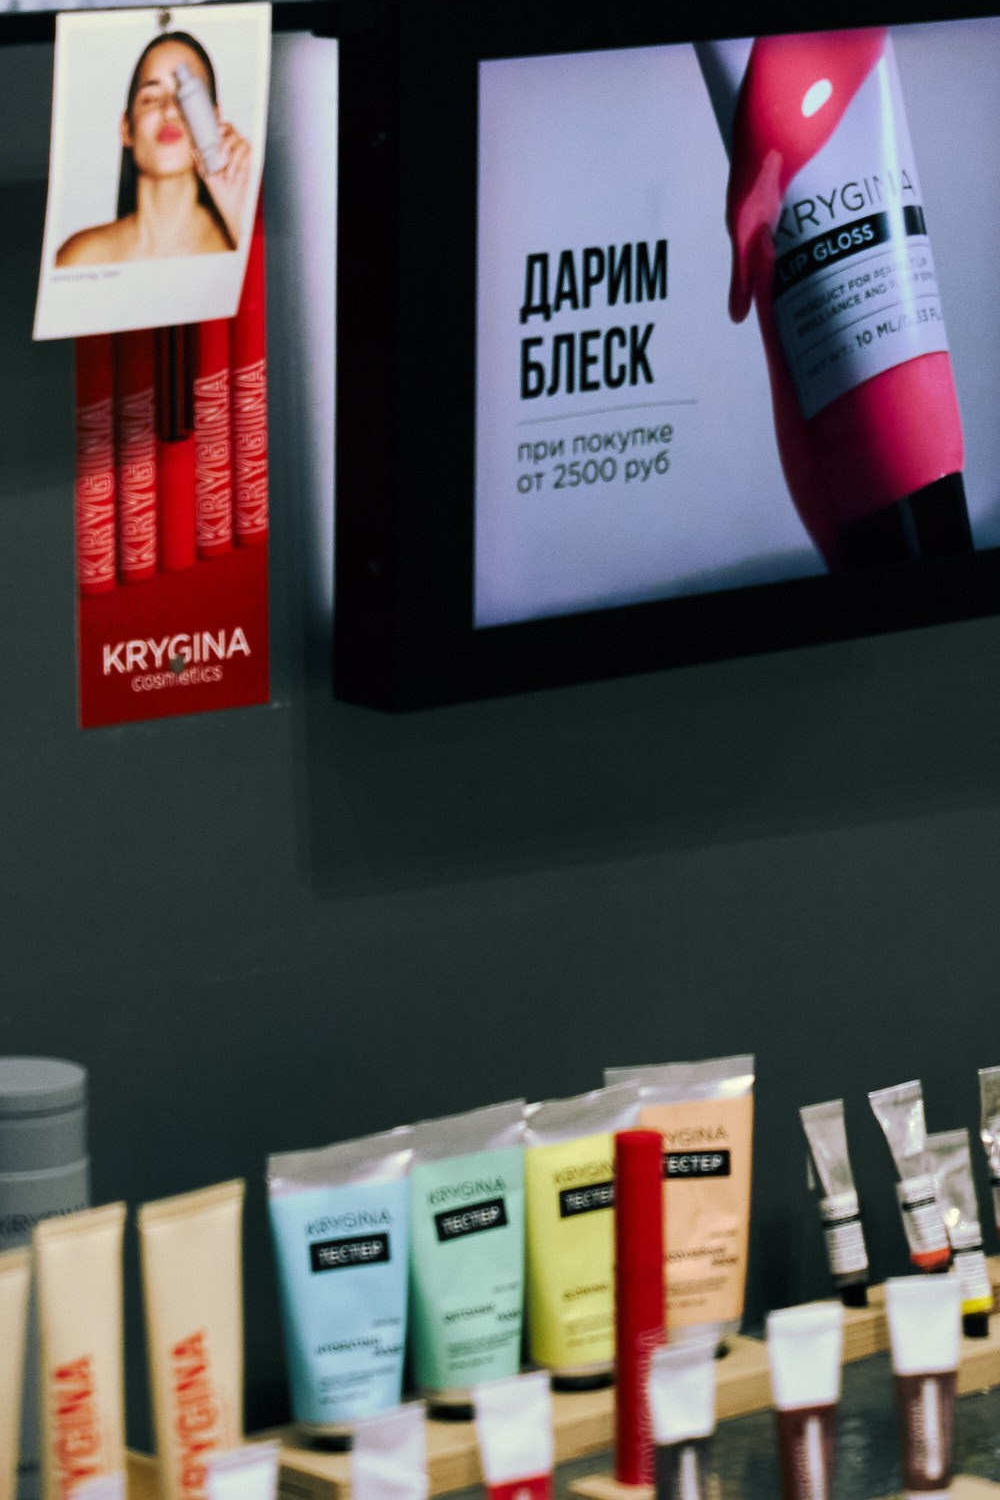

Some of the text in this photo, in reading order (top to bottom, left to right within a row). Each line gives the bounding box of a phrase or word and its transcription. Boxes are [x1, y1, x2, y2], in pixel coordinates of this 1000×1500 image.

[813, 224, 875, 261] GLOSS
[519, 239, 668, 325] ДАРИМ
[848, 275, 872, 290] FOR
[856, 330, 874, 348] 10
[520, 323, 655, 400] БЛЕСК
[194, 368, 230, 547] KRYGINA
[233, 360, 267, 535] KRYGINA
[518, 423, 674, 465] при покупке
[77, 398, 115, 584] KRYGINA
[120, 387, 156, 571] KRYGINA
[517, 449, 670, 494] от 2500 руб
[103, 626, 250, 675] KRYGINA
[131, 665, 222, 693] cosmetics
[428, 1176, 506, 1204] KRYGINA
[306, 1208, 391, 1236] KRYGINA
[441, 1206, 501, 1233] ТЕСТЕР
[318, 1240, 383, 1266] ТЕСТЕР
